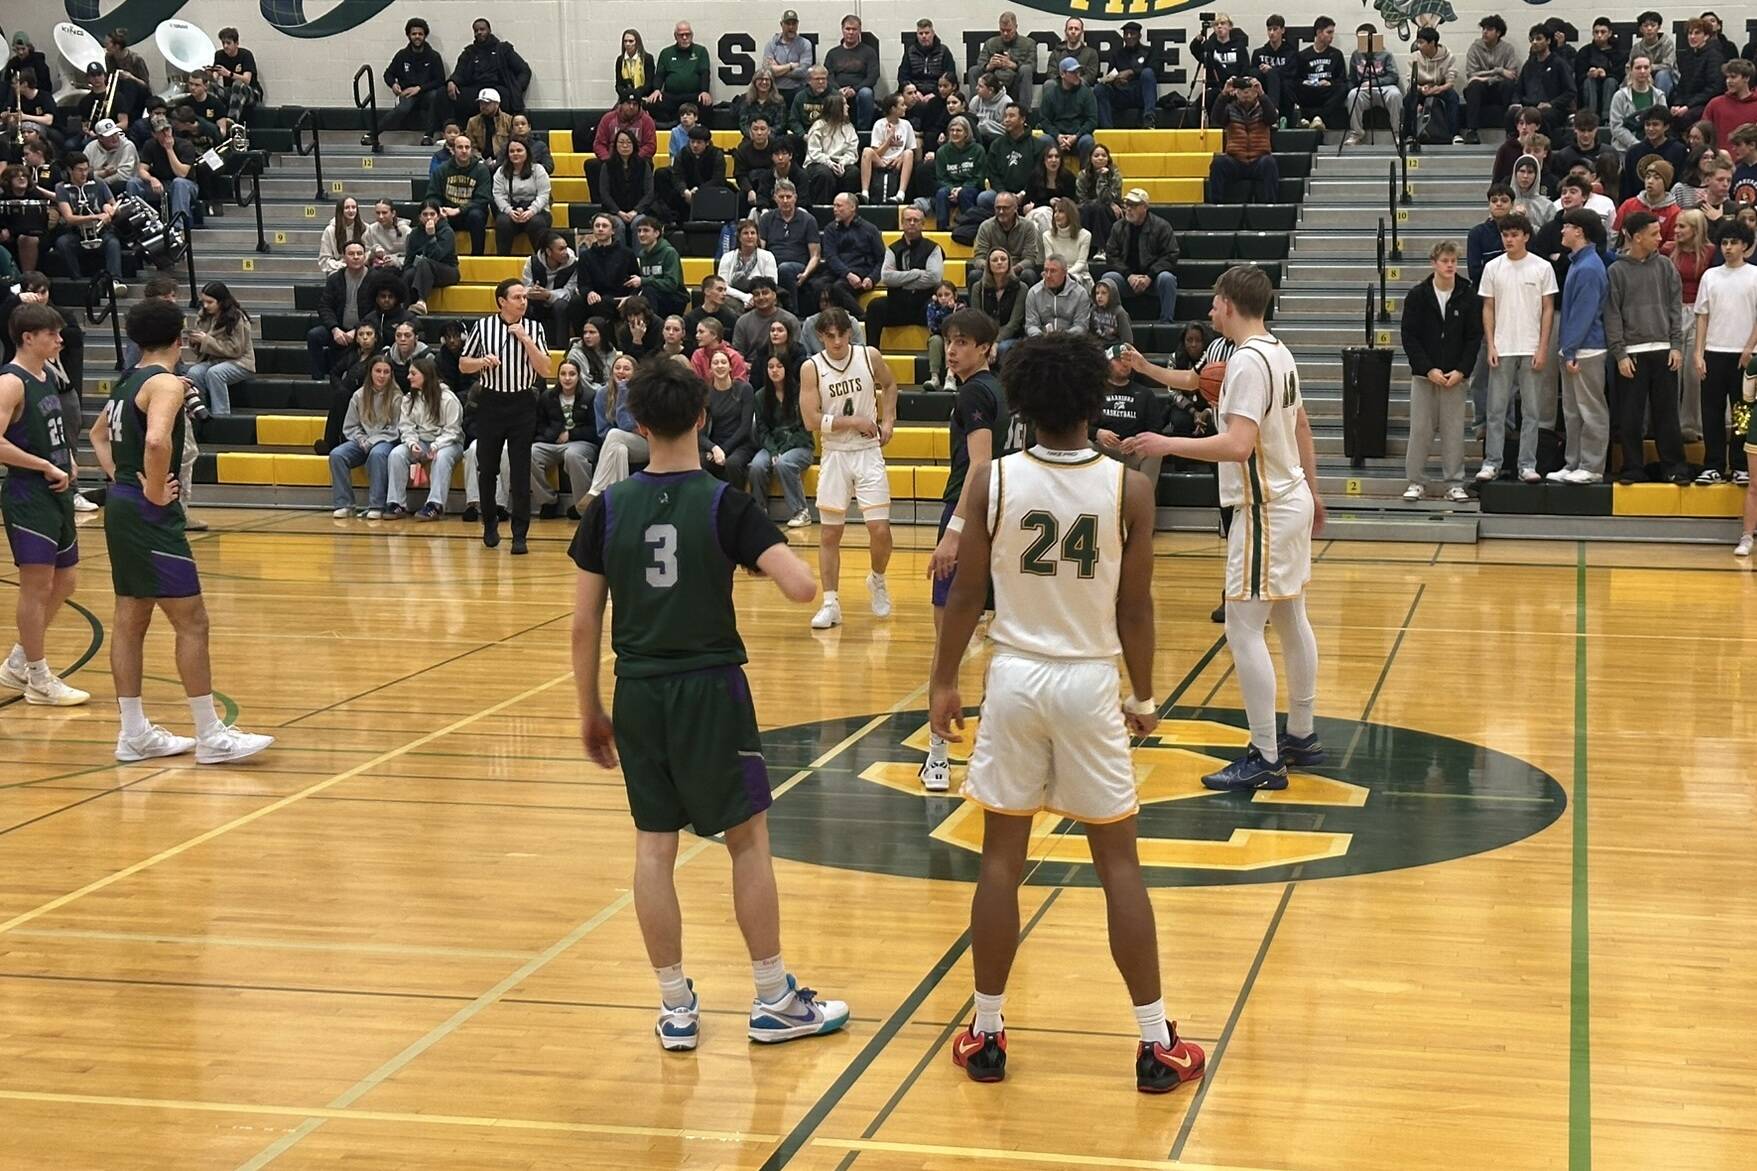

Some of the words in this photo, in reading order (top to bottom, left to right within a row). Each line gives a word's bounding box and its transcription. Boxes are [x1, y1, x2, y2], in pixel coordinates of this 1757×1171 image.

[1259, 55, 1286, 67] TEXAS
[1380, 334, 1386, 342] 6
[829, 378, 862, 398] SCOTS
[1105, 395, 1134, 403] WARRIORS
[843, 398, 854, 417] 4
[1103, 409, 1137, 419] BASKETBALL
[1351, 482, 1357, 490] 2
[1020, 510, 1100, 580] 24
[644, 524, 678, 588] 3
